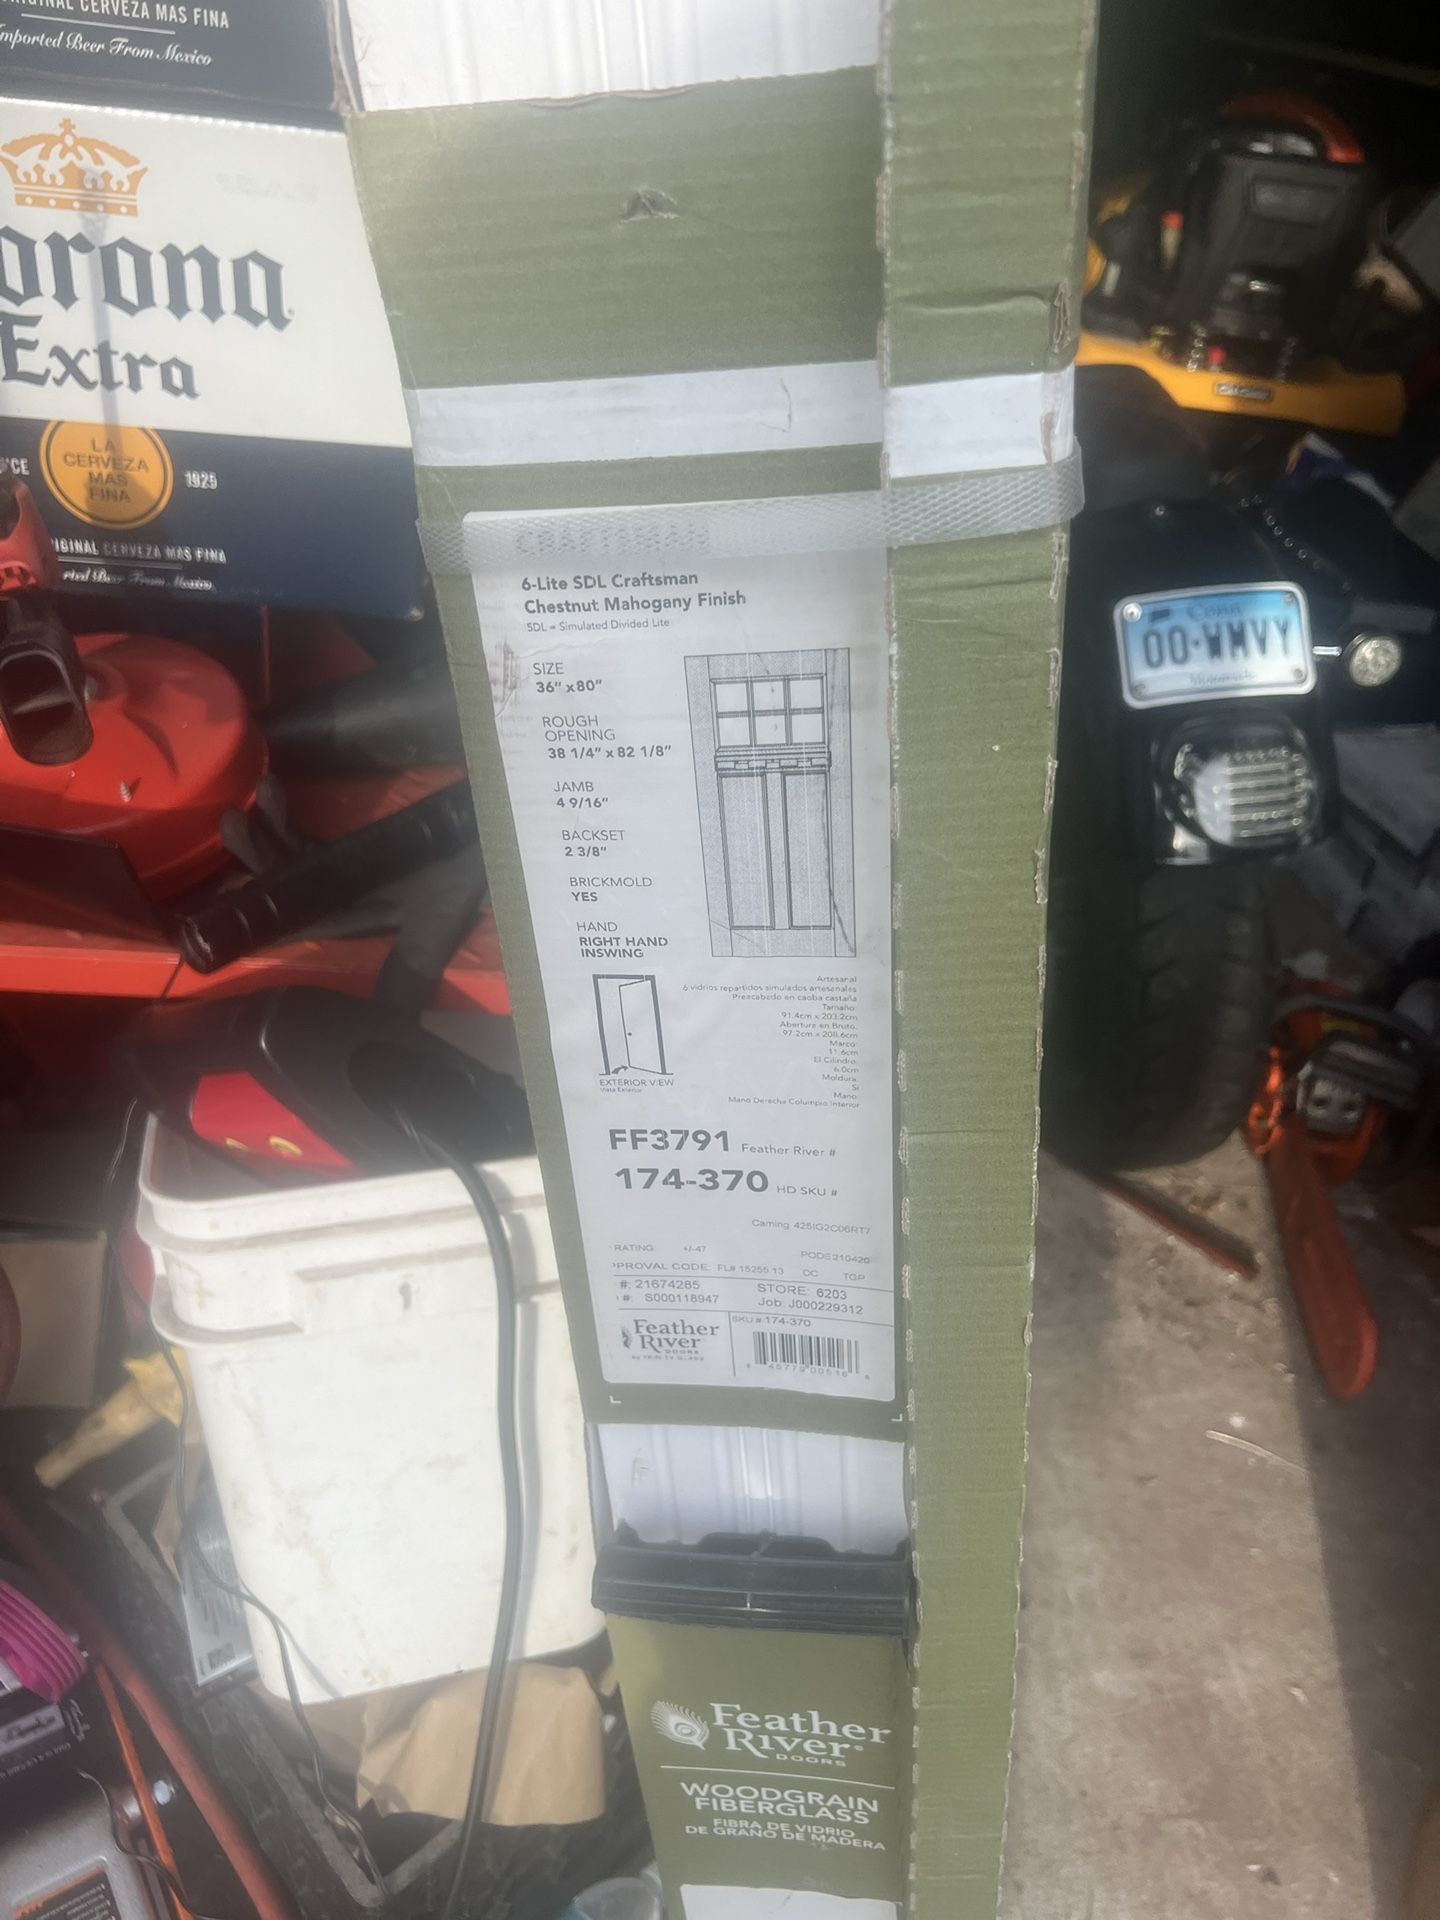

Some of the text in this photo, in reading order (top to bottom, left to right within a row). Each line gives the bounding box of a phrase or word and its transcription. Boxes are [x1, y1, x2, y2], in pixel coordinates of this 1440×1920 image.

[80, 0, 150, 20] CERVEZA
[155, 3, 188, 24] MAS
[193, 7, 229, 29] FINA
[65, 31, 105, 53] Beer
[109, 36, 154, 59] From
[155, 43, 212, 66] Mexico
[0, 310, 200, 399] Extra
[91, 437, 117, 453] LA
[63, 452, 149, 472] CERVEZA
[88, 472, 129, 487] MAS
[184, 471, 218, 490] 1925
[88, 487, 131, 503] FINA
[164, 546, 193, 562] MAS
[195, 547, 227, 565] FINA
[521, 571, 699, 591] 6-Lite SDL Craftsman
[524, 590, 746, 614] Chestnut Mahogany Finish
[527, 622, 547, 632] SDL
[559, 619, 608, 631] Simulated
[610, 618, 649, 629] Divided
[652, 617, 671, 628] Lite
[532, 662, 565, 676] SIZE
[542, 715, 599, 728] ROUGH
[544, 728, 616, 742] OPENING
[548, 747, 566, 759] 38
[617, 746, 635, 758] 82
[554, 781, 595, 793] JAMB
[556, 797, 565, 808] 4
[561, 829, 626, 841] BACKSET
[565, 846, 574, 857] 2
[569, 877, 653, 887] BRICKMOLD
[571, 891, 599, 902] YES
[576, 921, 618, 932] HAND
[579, 936, 669, 948] RIGHT HAND
[580, 948, 644, 958] INSWING
[600, 1078, 674, 1087] EXTERIOR VIEW
[608, 1128, 729, 1152] FF3791
[741, 1143, 788, 1155] Feather
[793, 1145, 825, 1157] River
[615, 1167, 769, 1193] 174-370
[776, 1184, 797, 1195] HD
[800, 1186, 826, 1197] SKU
[614, 1244, 654, 1252] RATING
[634, 1279, 700, 1290] 21674285
[816, 1287, 847, 1300] 6203
[644, 1293, 719, 1304] S000118947
[788, 1298, 864, 1315] J000229312
[633, 1319, 719, 1336] Feather
[765, 1316, 811, 1328] 174-370
[639, 1334, 701, 1353] River
[709, 1702, 892, 1744] Feather
[723, 1726, 851, 1759] River
[775, 1753, 847, 1767] DOORS
[680, 1782, 879, 1813] WOODGRAIN
[695, 1797, 870, 1825] FIBERGLASS
[713, 1818, 856, 1838] FIBRA DE VIDRIO
[685, 1825, 887, 1851] DE GRANO DE MADERA
